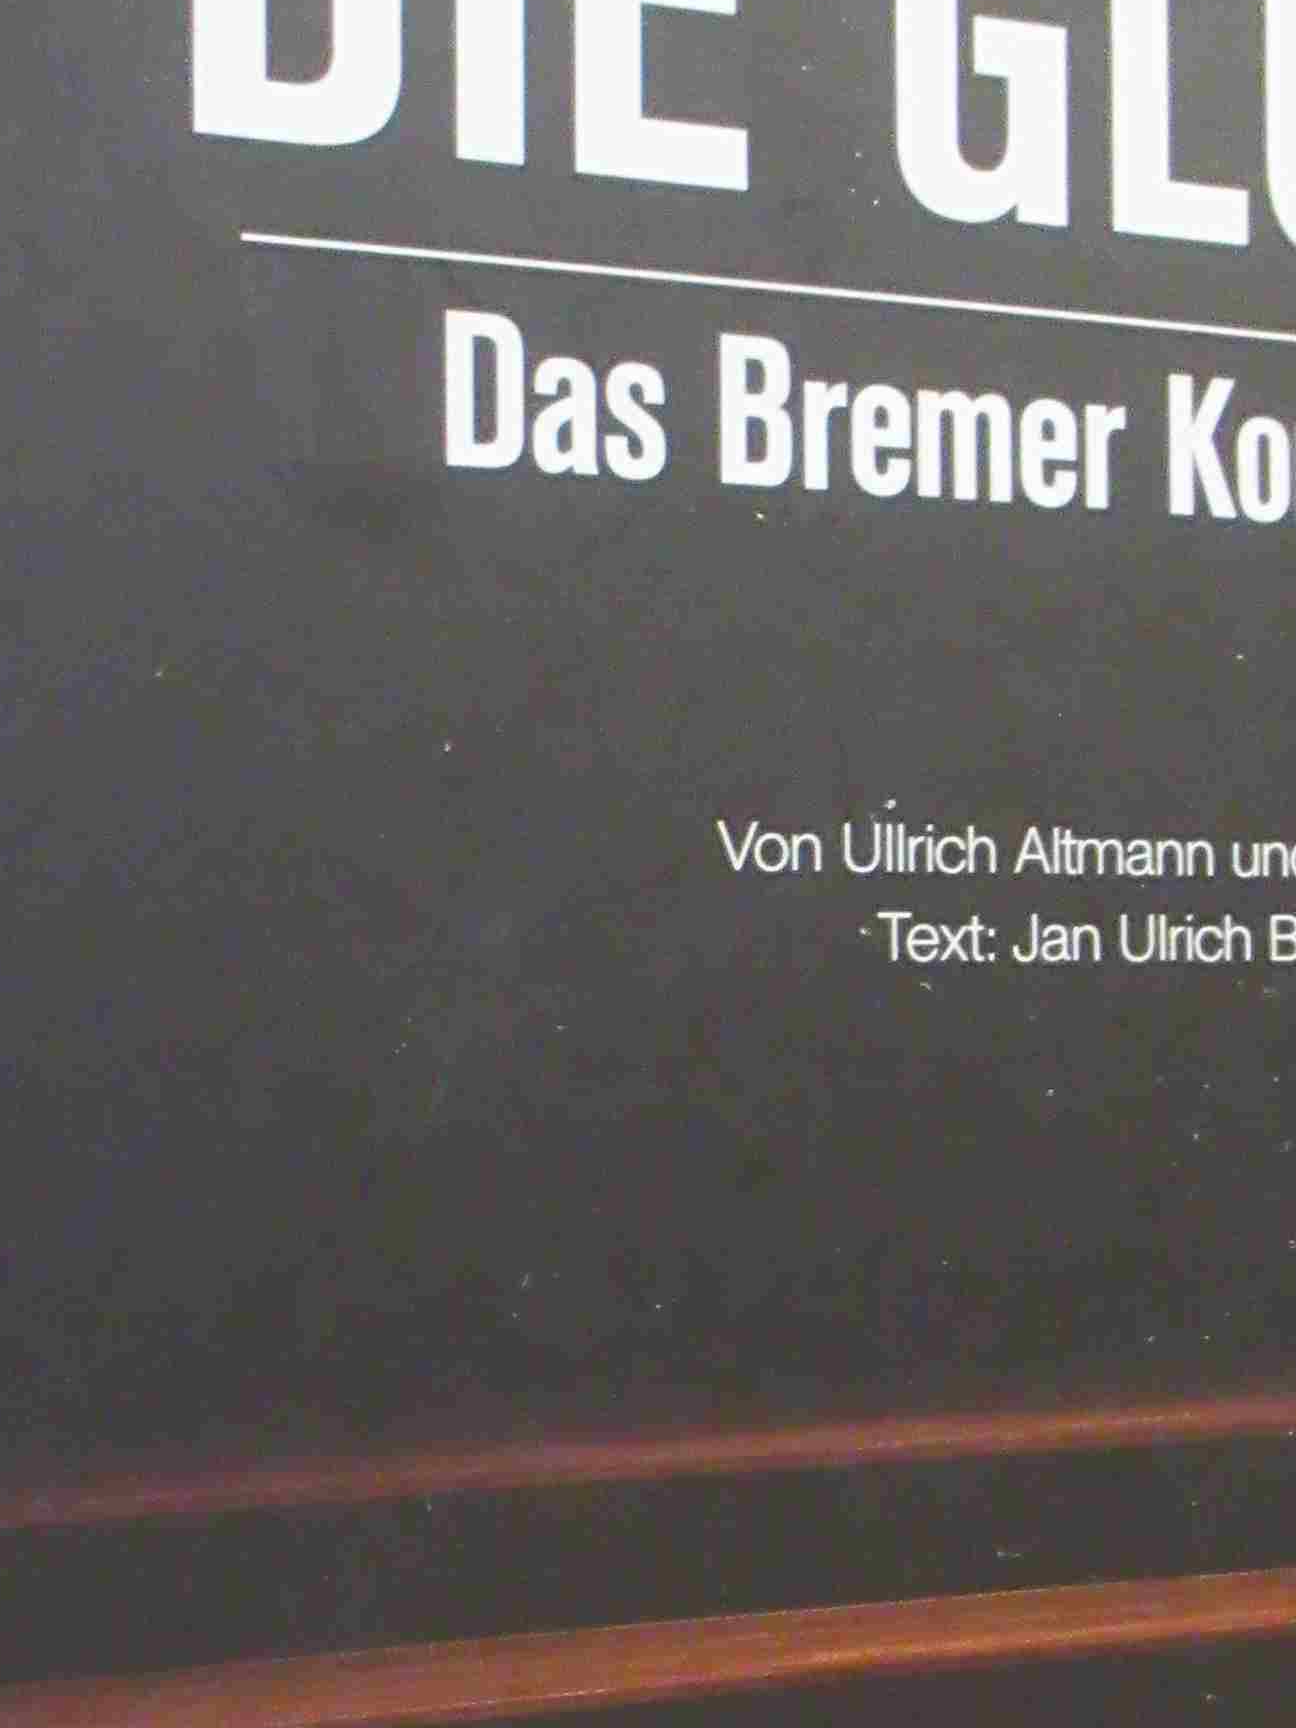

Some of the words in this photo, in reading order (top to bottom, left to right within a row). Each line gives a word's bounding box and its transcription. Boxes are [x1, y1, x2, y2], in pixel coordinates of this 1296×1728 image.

[444, 308, 667, 481] Das
[718, 332, 1127, 510] Bremer
[716, 820, 822, 873] Von
[843, 822, 997, 875] Ullrich
[1013, 826, 1215, 877] Altmann
[876, 911, 996, 963] Text:
[1012, 913, 1102, 963] Jan
[1120, 913, 1252, 963] Ulrich
